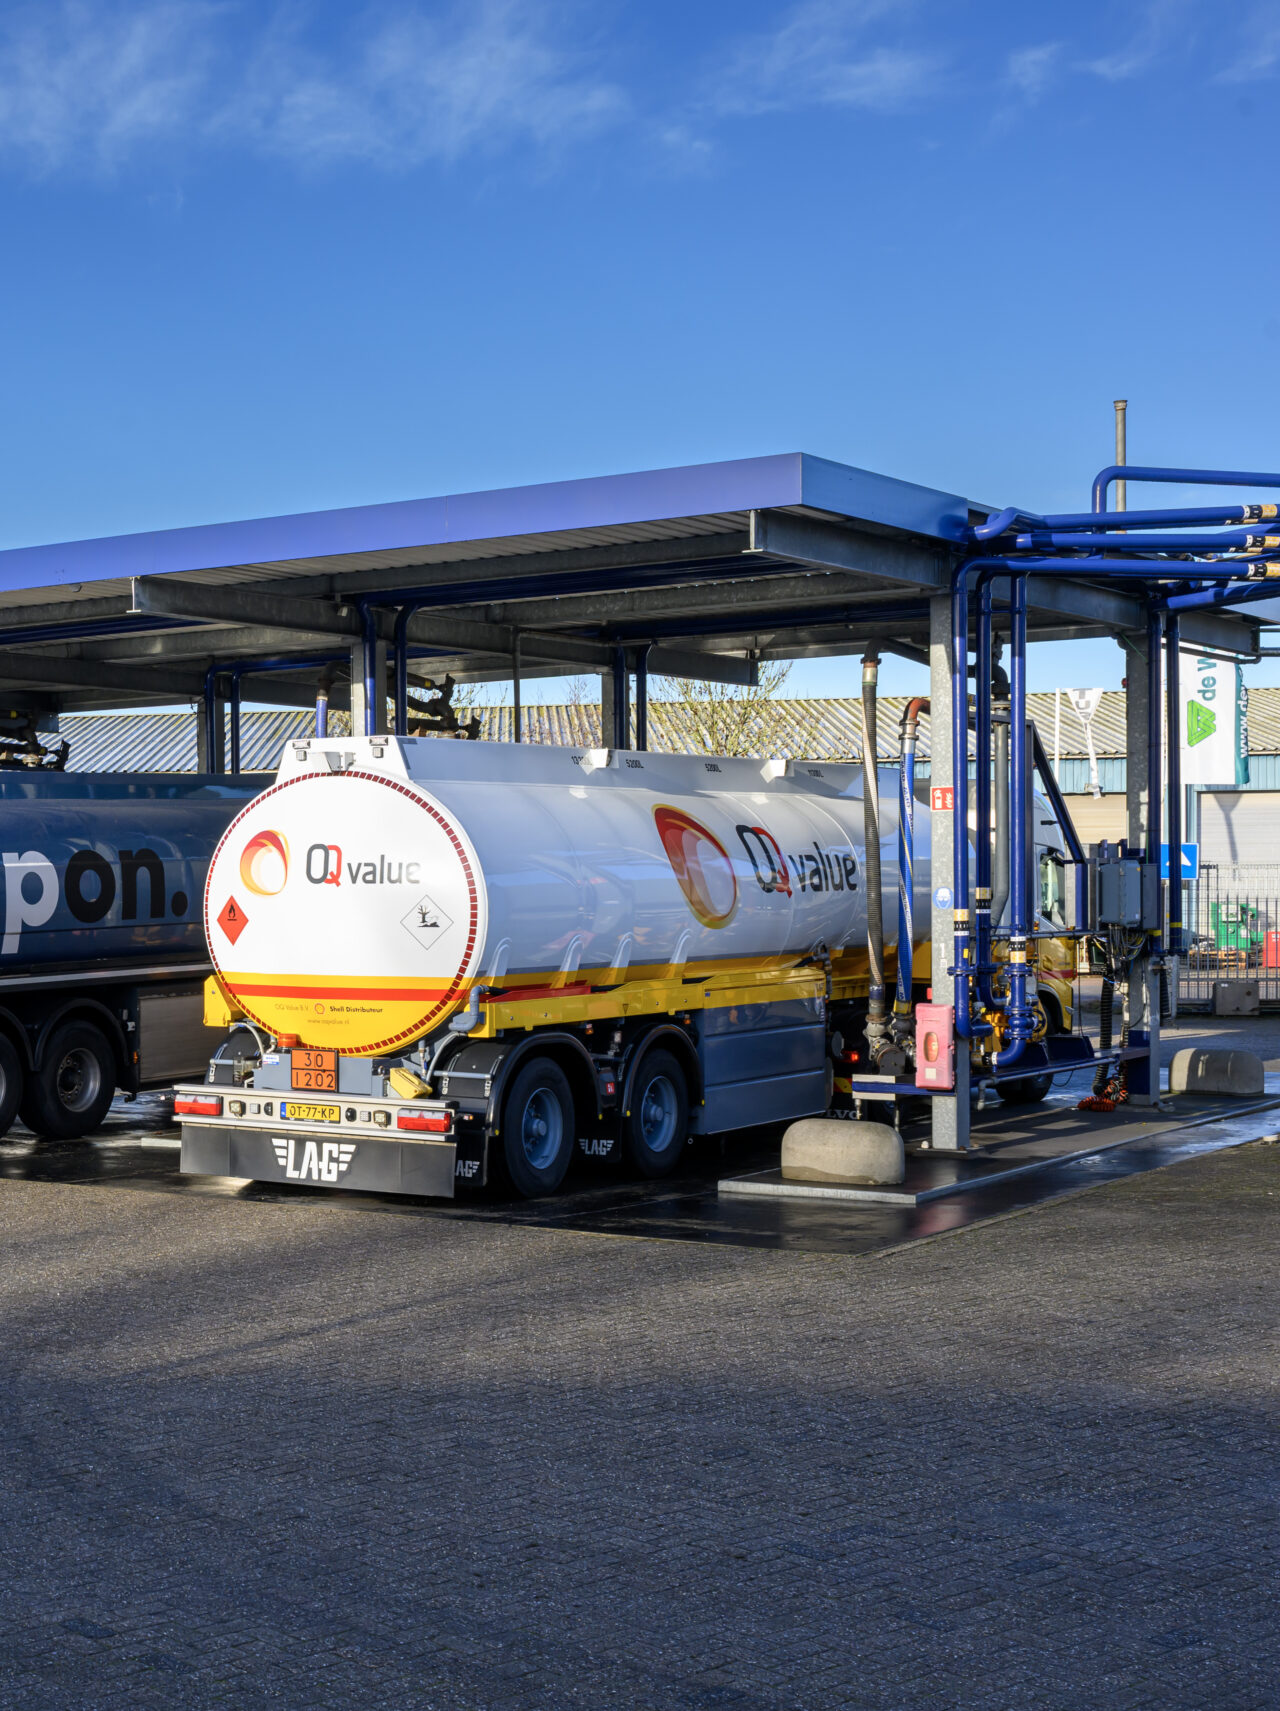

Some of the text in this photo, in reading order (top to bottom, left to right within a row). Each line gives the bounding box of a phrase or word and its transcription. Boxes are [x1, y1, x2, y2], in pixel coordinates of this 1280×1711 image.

[347, 854, 421, 884] value
[787, 841, 857, 892] value
[304, 1052, 324, 1068] 30
[295, 1072, 334, 1088] 1202
[289, 1105, 335, 1119] OT-77-KP
[583, 1139, 609, 1155] LAG
[282, 1139, 342, 1182] LAG
[455, 1159, 475, 1178] AG
